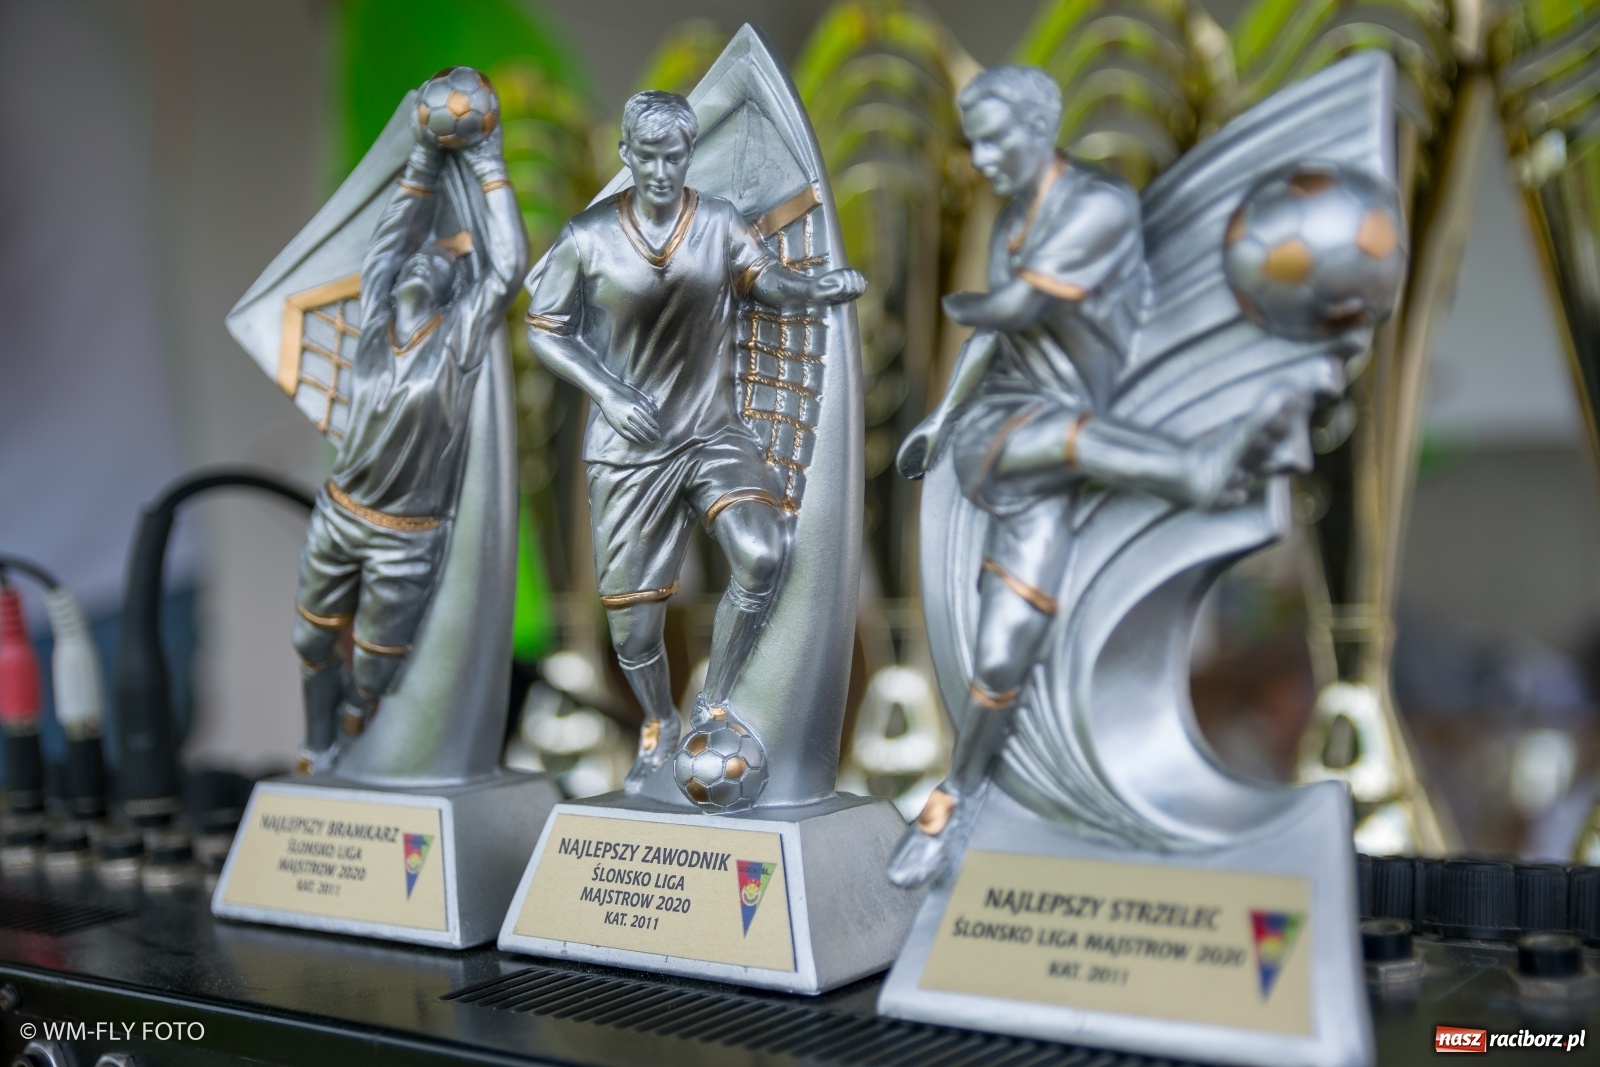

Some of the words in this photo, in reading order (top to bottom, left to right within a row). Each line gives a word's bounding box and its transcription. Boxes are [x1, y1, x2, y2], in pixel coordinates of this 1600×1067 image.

[558, 837, 639, 861] NAJLEPSZY
[641, 846, 731, 871] ZAWODNIK
[338, 866, 367, 882] 2020
[591, 863, 651, 887] ŚLONSKO
[654, 873, 685, 891] LIGA
[580, 886, 653, 910] MAJSTROW
[656, 896, 691, 914] 2020
[984, 887, 1105, 919] NAJLEPSZY
[1109, 899, 1223, 932] STRZELEC
[604, 911, 627, 927] KAT.
[630, 915, 659, 931] 2011
[953, 916, 1033, 945] ŚLONSKO
[1037, 927, 1079, 949] LIGA
[1083, 933, 1191, 964] MAJSTROW
[1195, 946, 1247, 969] 2020
[1047, 960, 1083, 982] KAT.
[1087, 964, 1130, 986] 2011
